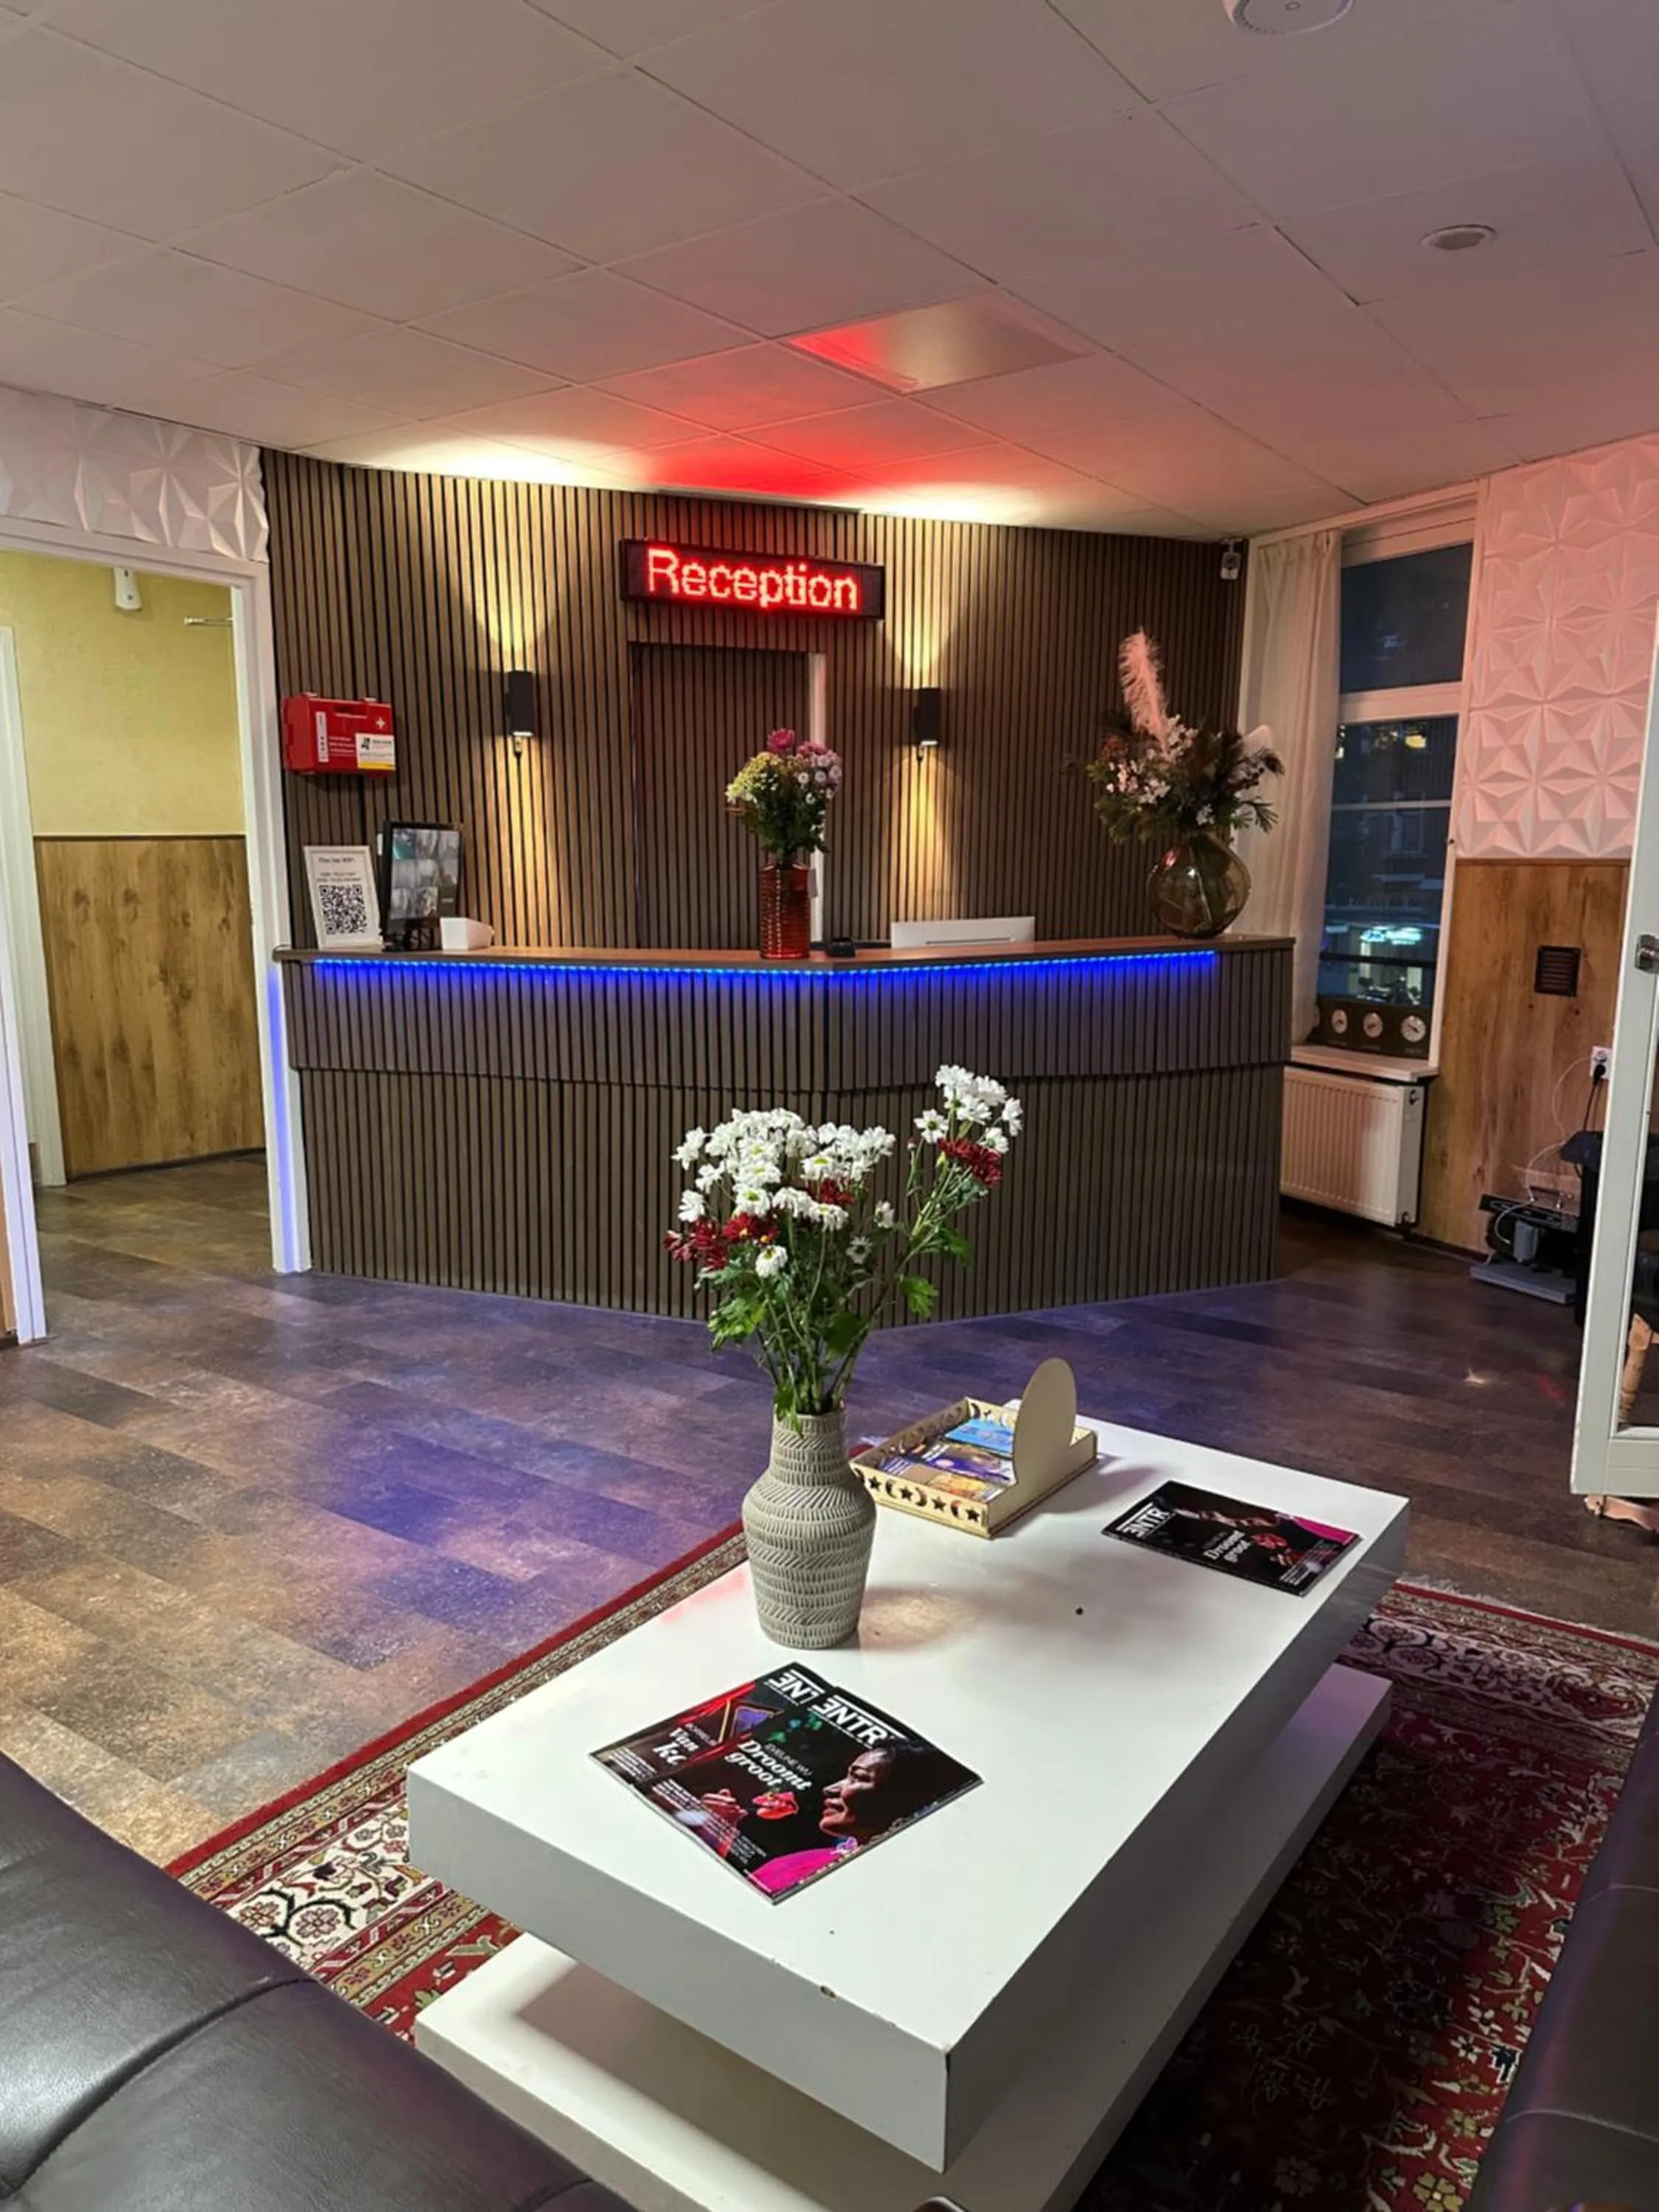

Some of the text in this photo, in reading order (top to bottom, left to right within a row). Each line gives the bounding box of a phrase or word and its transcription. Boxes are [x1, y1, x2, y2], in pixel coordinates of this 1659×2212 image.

[647, 548, 858, 609] Reception
[724, 1752, 783, 1787] groot
[737, 1739, 813, 1791] Droomt
